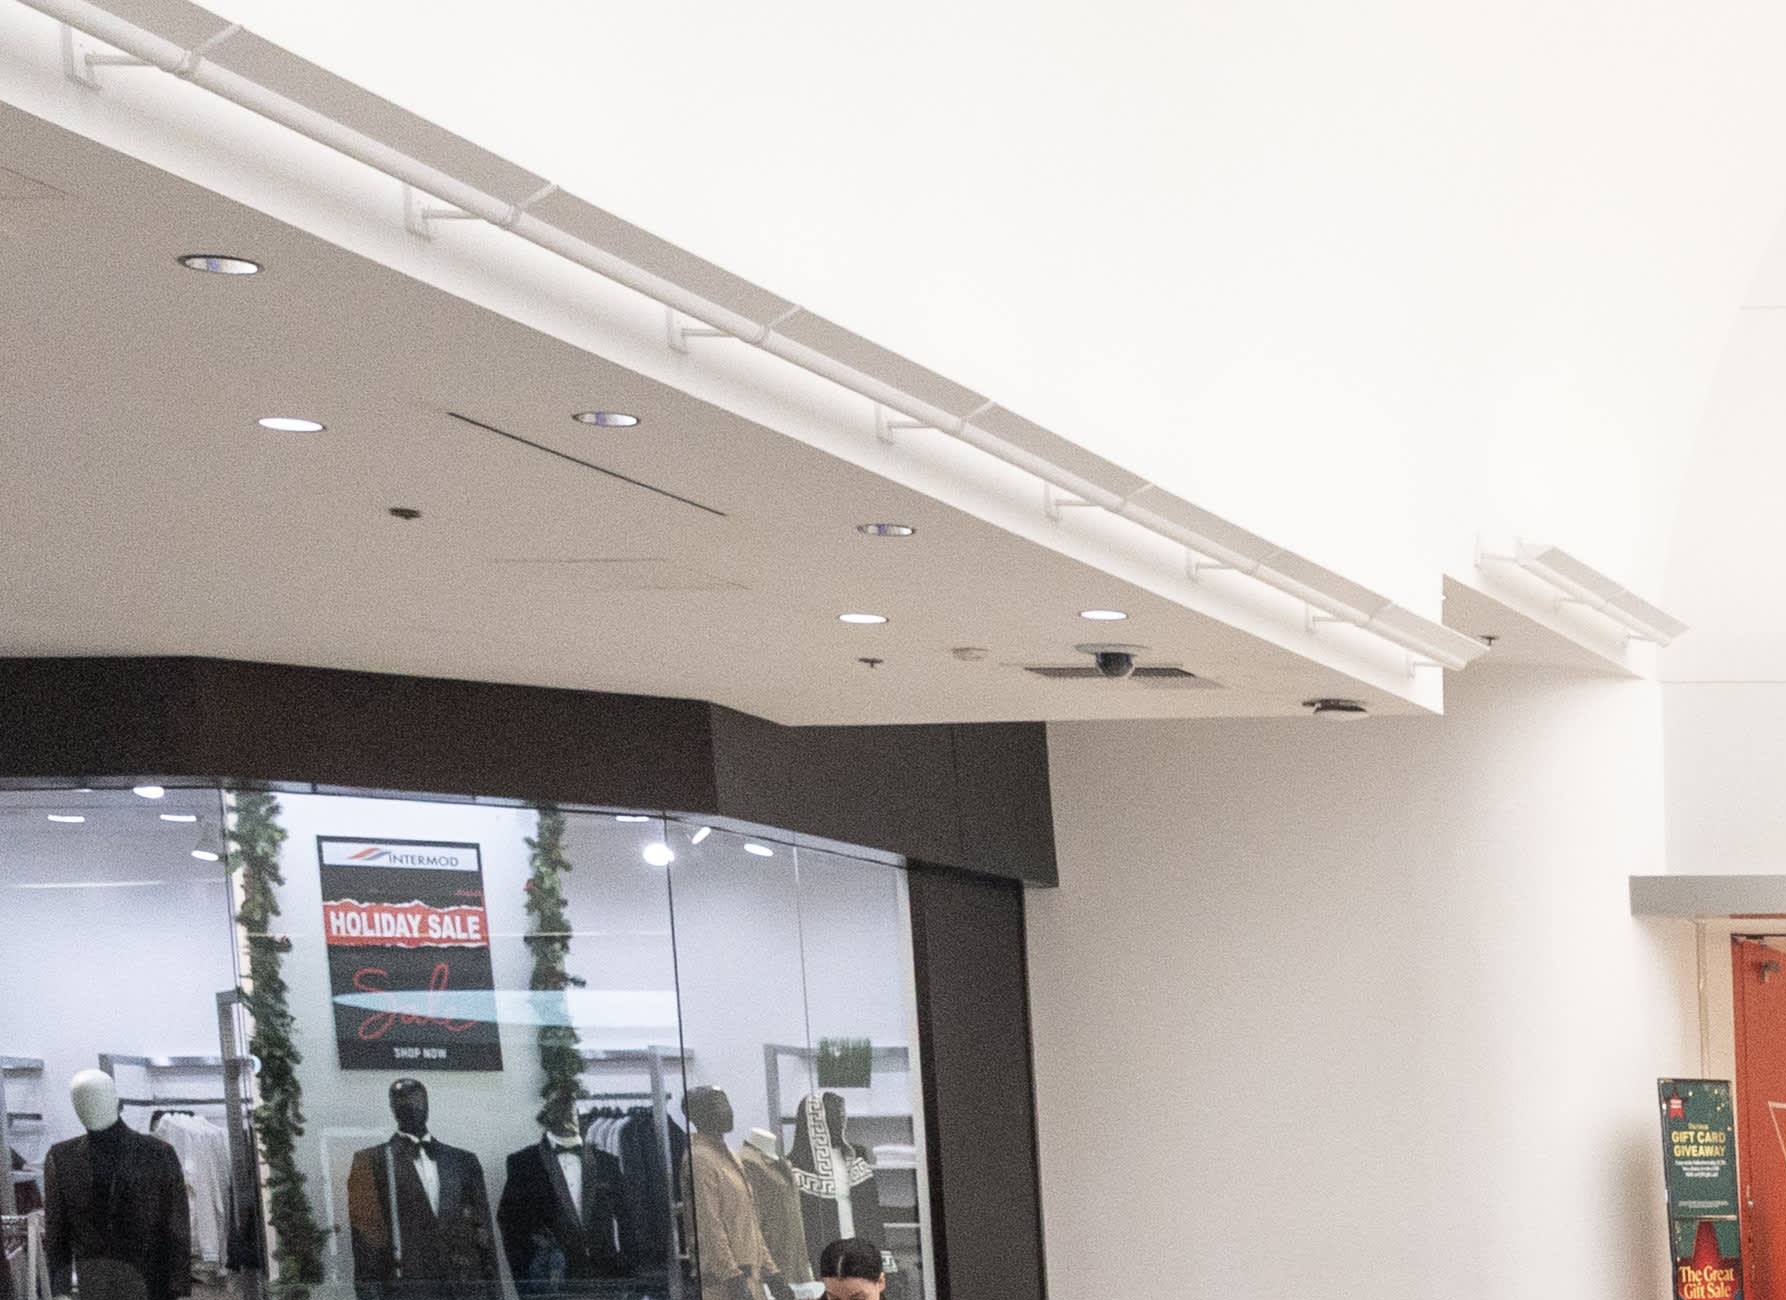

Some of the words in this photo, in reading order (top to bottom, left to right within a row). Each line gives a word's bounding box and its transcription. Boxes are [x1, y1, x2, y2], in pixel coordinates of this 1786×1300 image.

[388, 853, 459, 867] INTERMOD
[329, 911, 422, 939] HOLIDAY
[427, 914, 482, 940] SALE
[1671, 1131, 1695, 1143] GIFT
[1696, 1131, 1726, 1143] CARD
[1673, 1145, 1726, 1157] GIVEAWAY
[1679, 1265, 1702, 1284] The
[1703, 1264, 1735, 1282] Great
[1683, 1282, 1706, 1299] Gift
[1706, 1282, 1732, 1299] Sale
